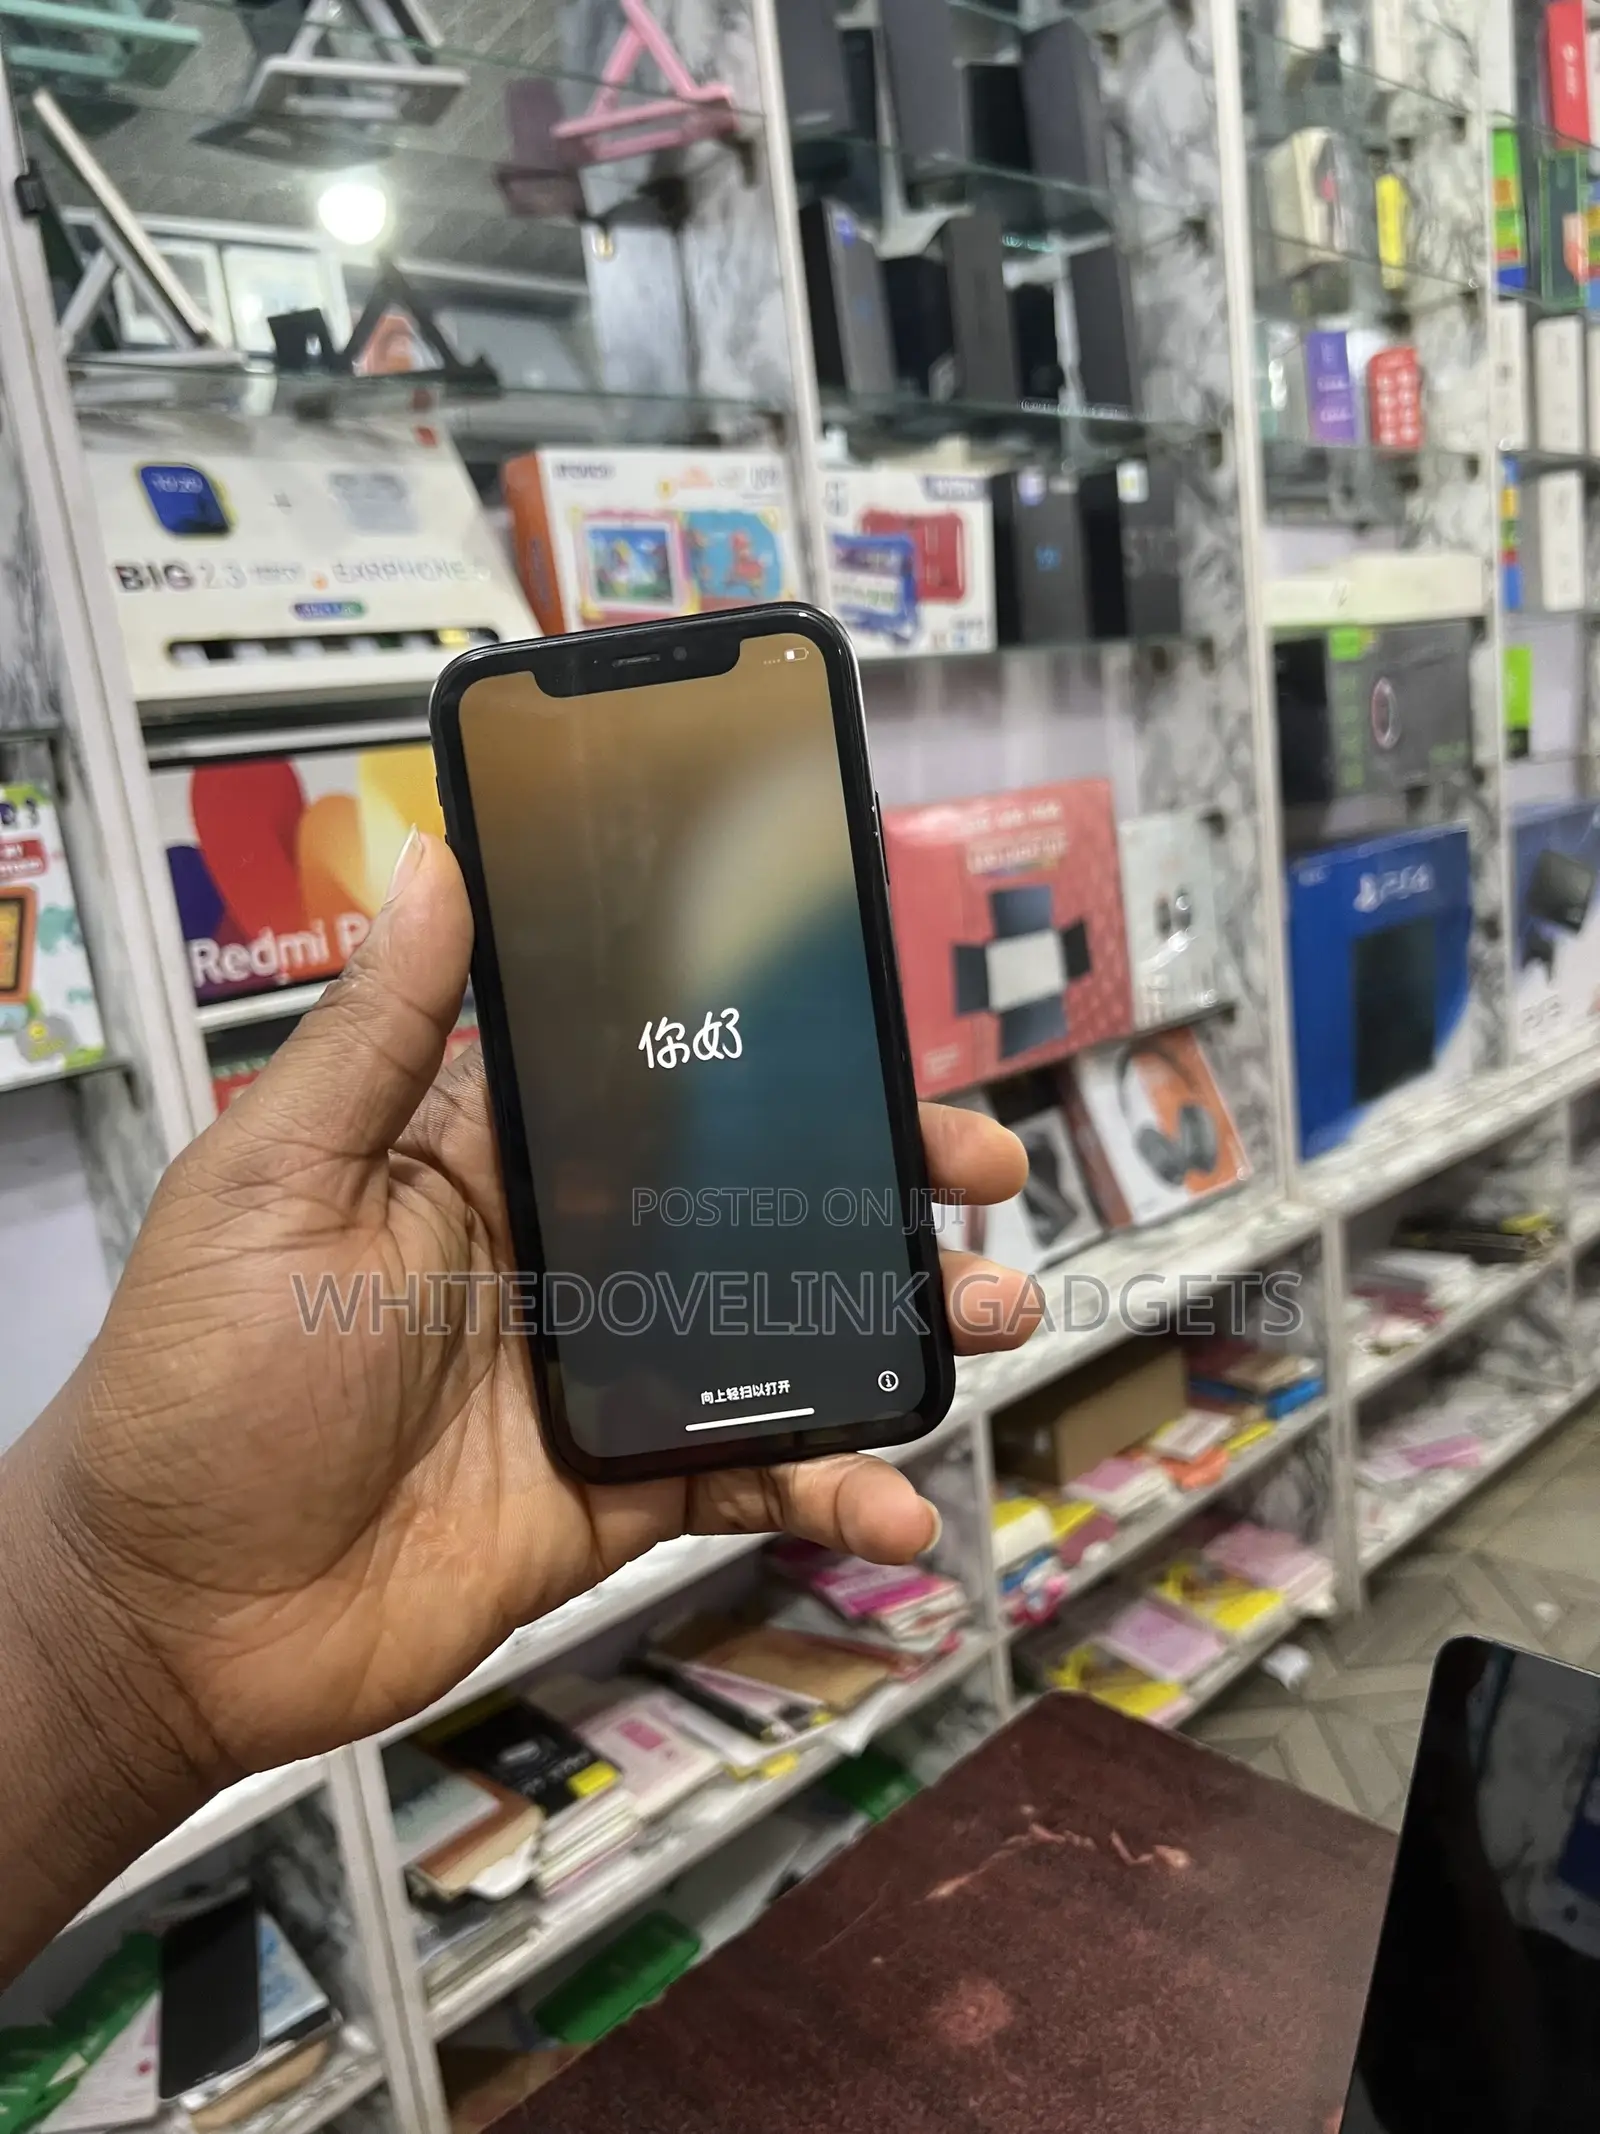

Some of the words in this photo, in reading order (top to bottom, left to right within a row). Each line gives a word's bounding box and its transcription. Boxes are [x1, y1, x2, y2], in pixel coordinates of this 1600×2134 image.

[114, 563, 196, 592] BIG
[189, 919, 329, 987] Redmi
[638, 1007, 743, 1069] 你好
[700, 1379, 791, 1405] 向上轻扫以打开
